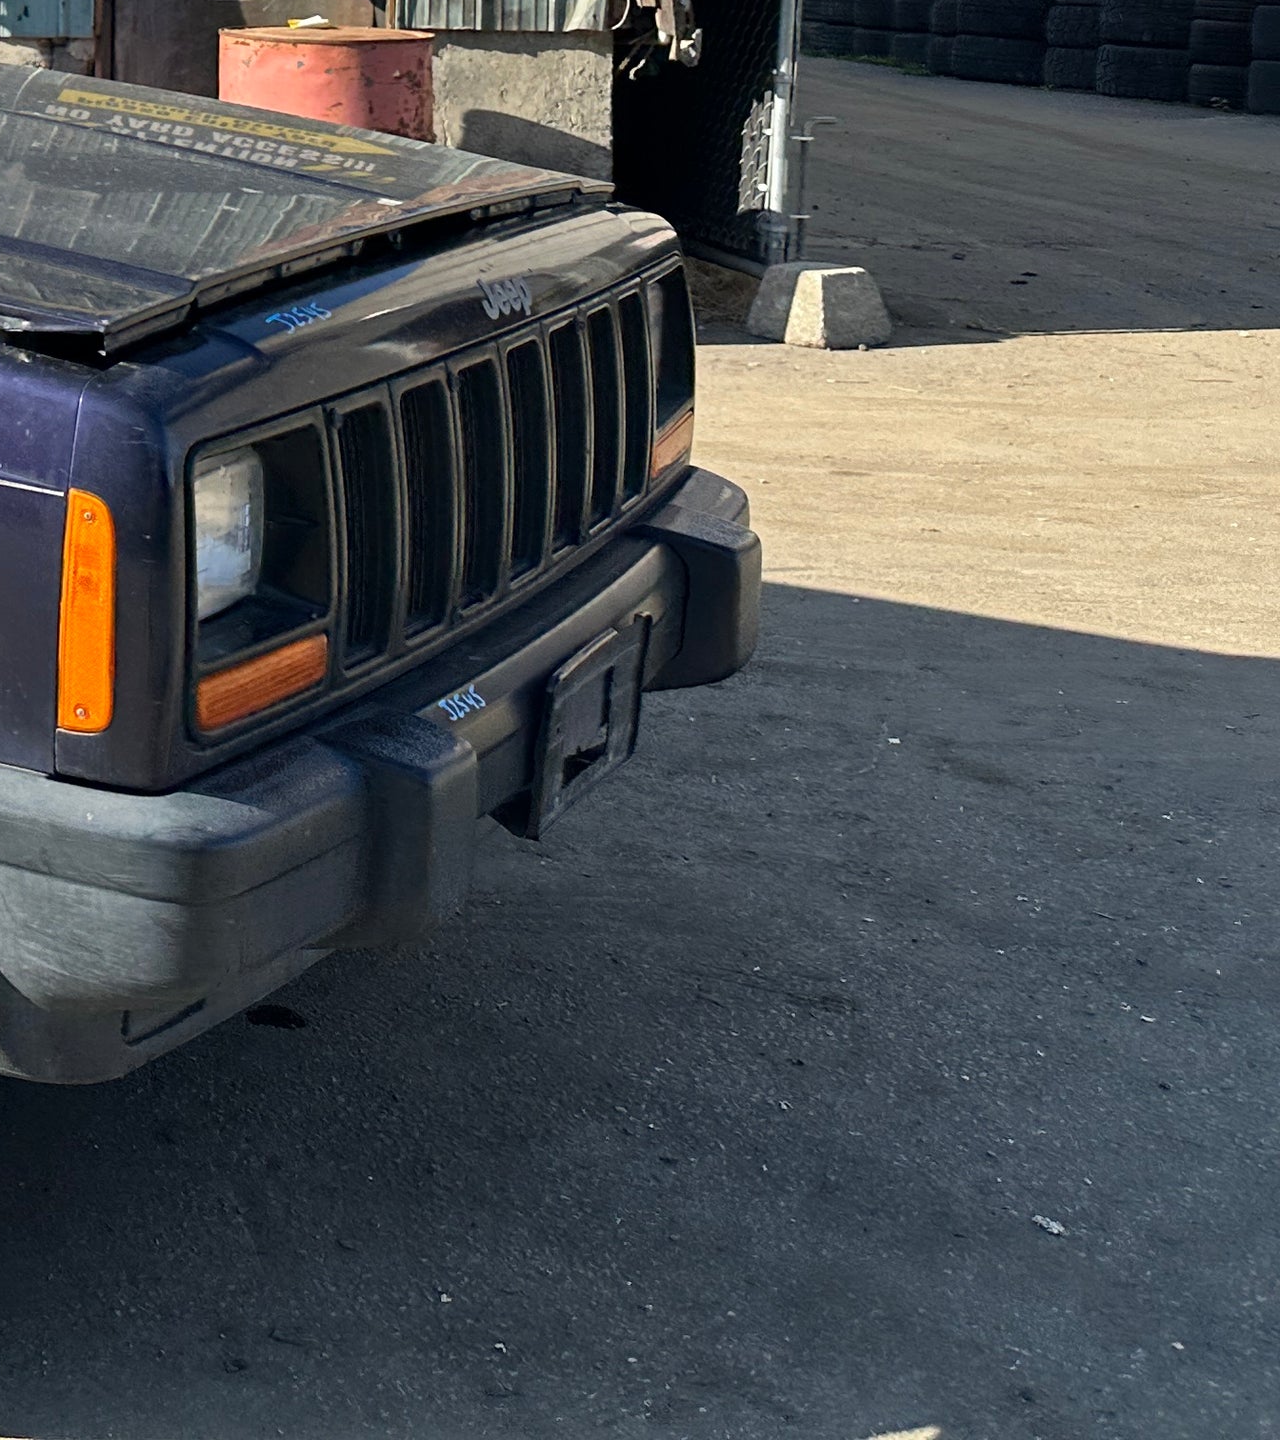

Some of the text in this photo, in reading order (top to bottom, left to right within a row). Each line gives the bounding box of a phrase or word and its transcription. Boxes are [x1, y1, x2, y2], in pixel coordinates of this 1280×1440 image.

[476, 277, 532, 320] Jeep
[265, 302, 332, 334] J2545
[438, 684, 486, 721] J2545
